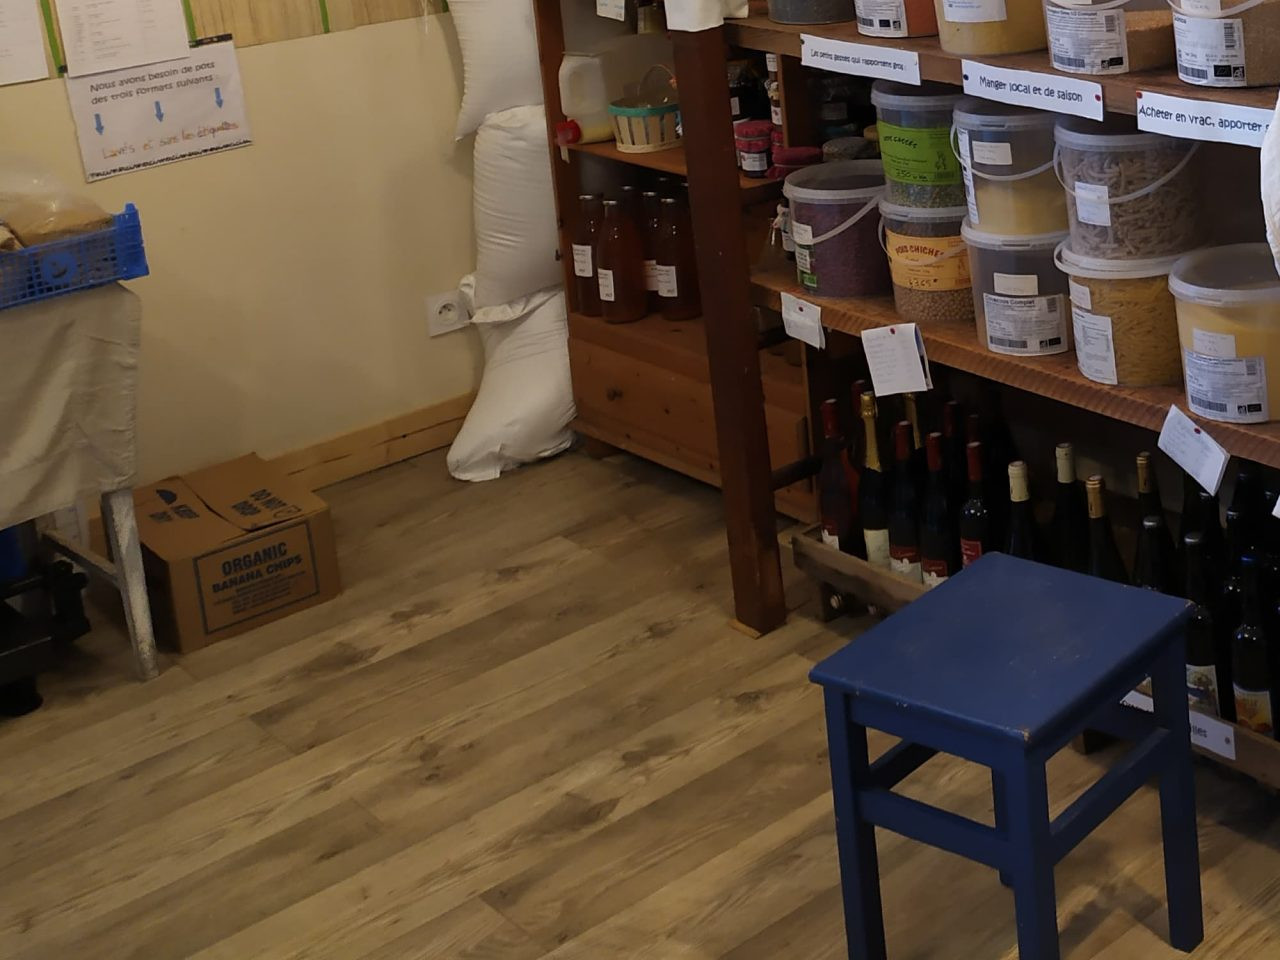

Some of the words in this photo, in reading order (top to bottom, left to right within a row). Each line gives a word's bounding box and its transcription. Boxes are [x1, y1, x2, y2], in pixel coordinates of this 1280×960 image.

[851, 54, 861, 66] qui
[89, 79, 116, 94] Nous
[118, 74, 146, 88] avons
[148, 67, 179, 81] besoin
[180, 63, 193, 74] de
[195, 60, 216, 74] pots
[91, 94, 109, 106] des
[111, 88, 134, 102] trois
[136, 81, 174, 97] formats
[175, 75, 214, 89] suivants
[978, 75, 1008, 92] Manger
[1008, 80, 1031, 95] local
[1032, 84, 1043, 96] et
[1043, 85, 1056, 98] de
[1056, 87, 1083, 102] saison
[1139, 105, 1173, 120] Acheter
[1175, 113, 1187, 122] en
[1188, 114, 1216, 128] vrac,
[1217, 118, 1262, 132] apporter
[1010, 297, 1036, 305] Complet
[211, 569, 264, 594] BANANA
[266, 553, 303, 575] CHIPS
[221, 541, 288, 577] ORGANIC
